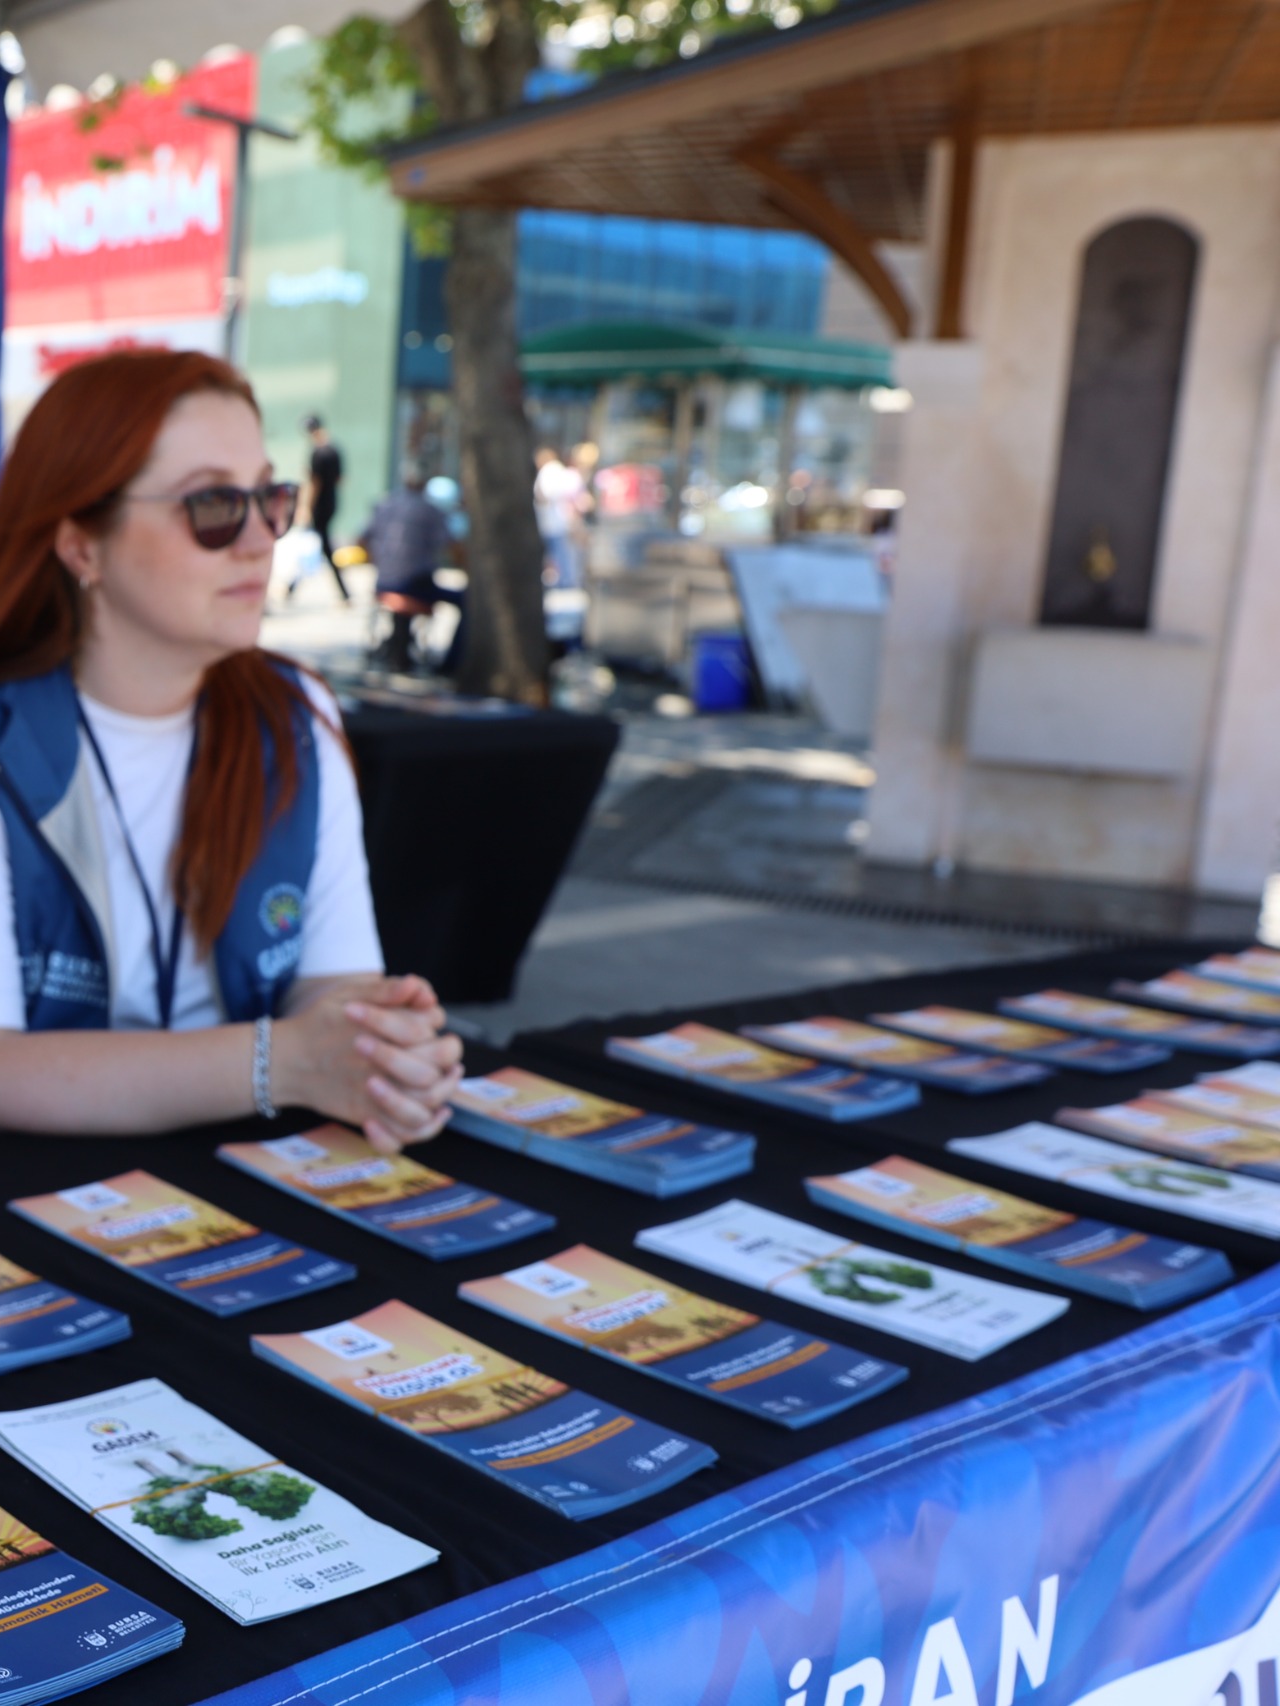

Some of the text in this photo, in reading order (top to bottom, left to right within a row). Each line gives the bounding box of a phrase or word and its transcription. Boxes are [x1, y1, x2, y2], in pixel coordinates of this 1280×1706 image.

[91, 1429, 160, 1454] GADEM
[217, 1522, 325, 1560] Daha Sağlıklı
[264, 1549, 314, 1571] Adımı
[315, 1537, 350, 1555] Atın
[316, 1560, 356, 1577] BURSA
[50, 1585, 103, 1610] Hizmeti
[107, 1610, 148, 1631] BURSA
